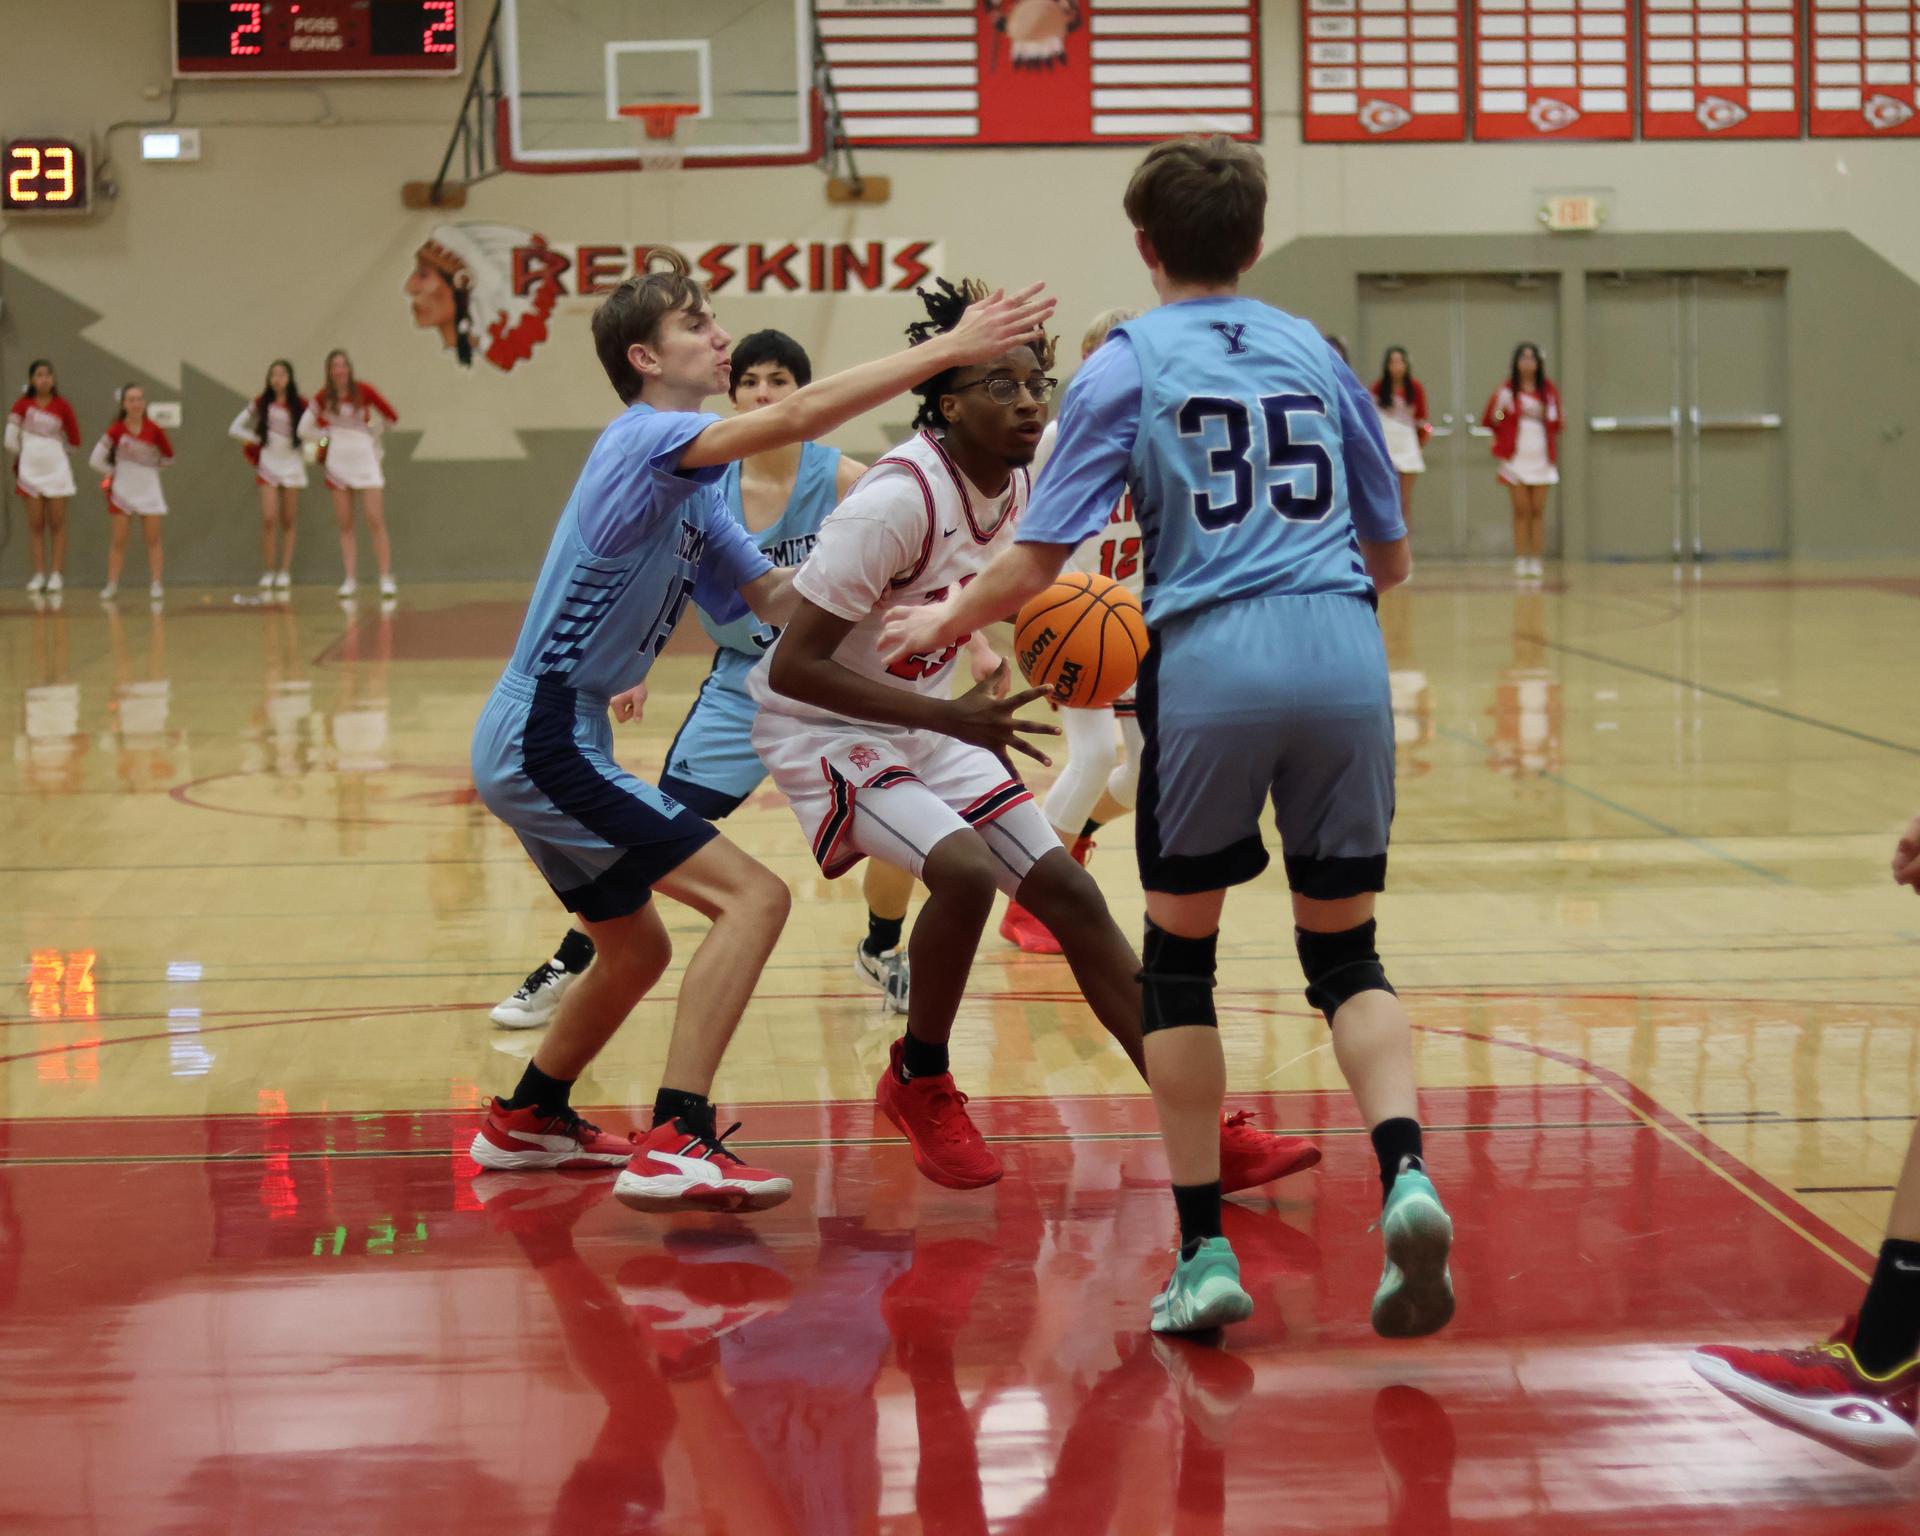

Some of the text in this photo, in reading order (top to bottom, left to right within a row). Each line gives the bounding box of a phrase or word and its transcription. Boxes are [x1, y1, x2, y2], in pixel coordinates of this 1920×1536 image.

[230, 3, 261, 54] 2
[423, 1, 455, 52] 2
[10, 147, 74, 201] 23
[1209, 321, 1249, 357] Y
[1177, 391, 1335, 534] 35
[1100, 537, 1142, 581] 12
